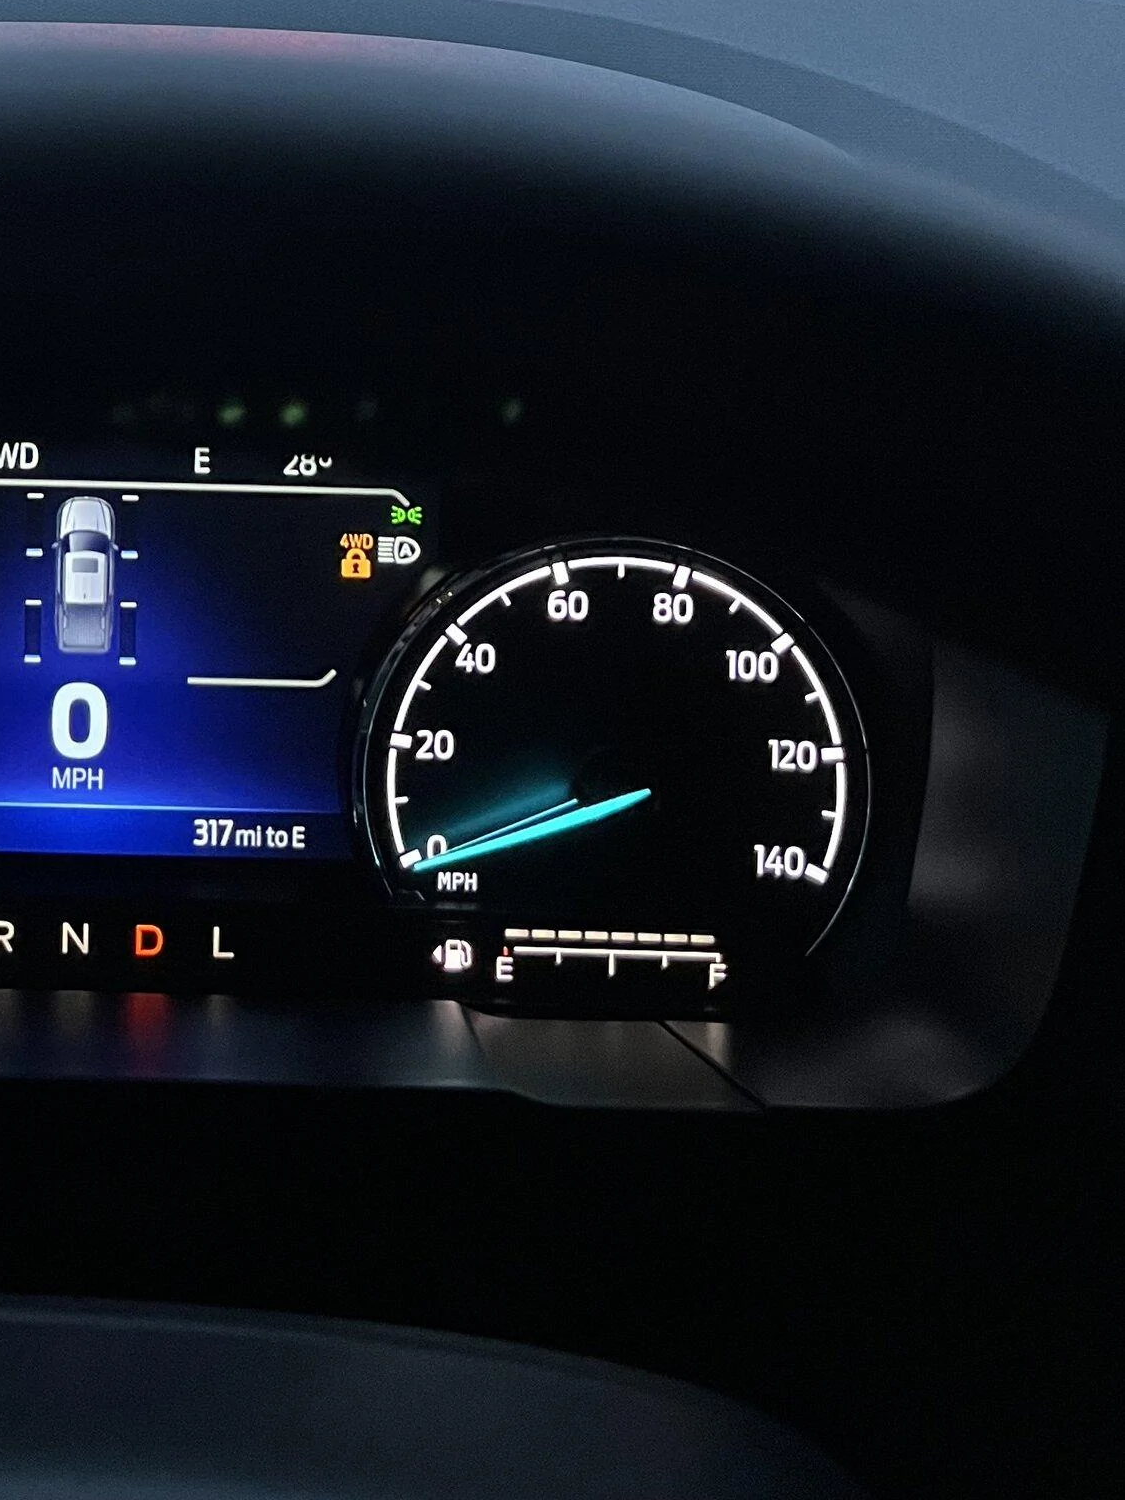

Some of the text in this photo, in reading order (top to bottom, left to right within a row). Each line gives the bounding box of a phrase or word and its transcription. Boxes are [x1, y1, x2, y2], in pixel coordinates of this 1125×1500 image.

[194, 447, 211, 475] E
[339, 533, 374, 550] 4WD
[547, 591, 589, 621] 60
[652, 593, 694, 624] 80
[455, 643, 496, 674] 40
[726, 650, 779, 682] 100
[51, 682, 108, 759] 0
[415, 730, 455, 761] 20
[768, 740, 818, 772] 120
[52, 766, 104, 790] MPH
[265, 826, 288, 848] to
[292, 826, 306, 848] E
[426, 834, 448, 858] 0
[754, 845, 808, 878] 140
[437, 872, 478, 892] MPH
[61, 921, 90, 954] N
[135, 924, 164, 957] D
[212, 926, 235, 959] L
[496, 957, 514, 982] E
[709, 964, 727, 990] F
